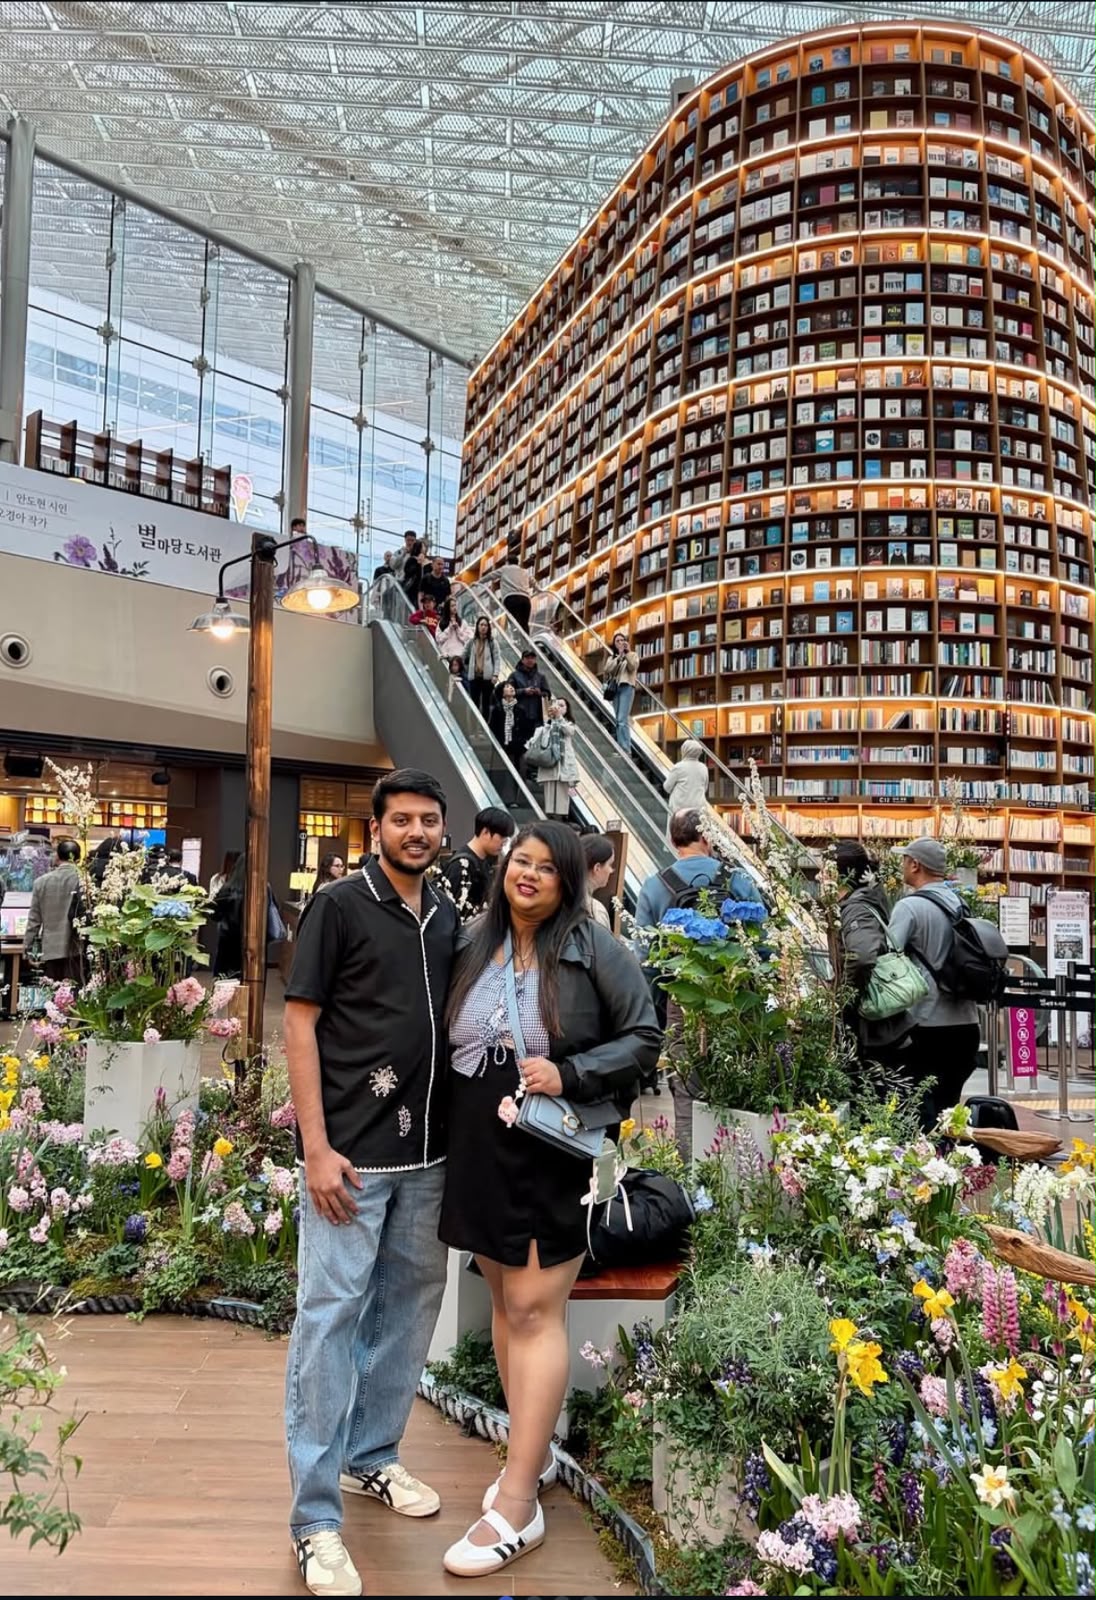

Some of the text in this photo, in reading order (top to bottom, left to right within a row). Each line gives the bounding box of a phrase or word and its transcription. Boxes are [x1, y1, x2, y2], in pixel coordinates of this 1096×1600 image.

[16, 493, 68, 515] 안도현 시인
[28, 515, 47, 528] 작가
